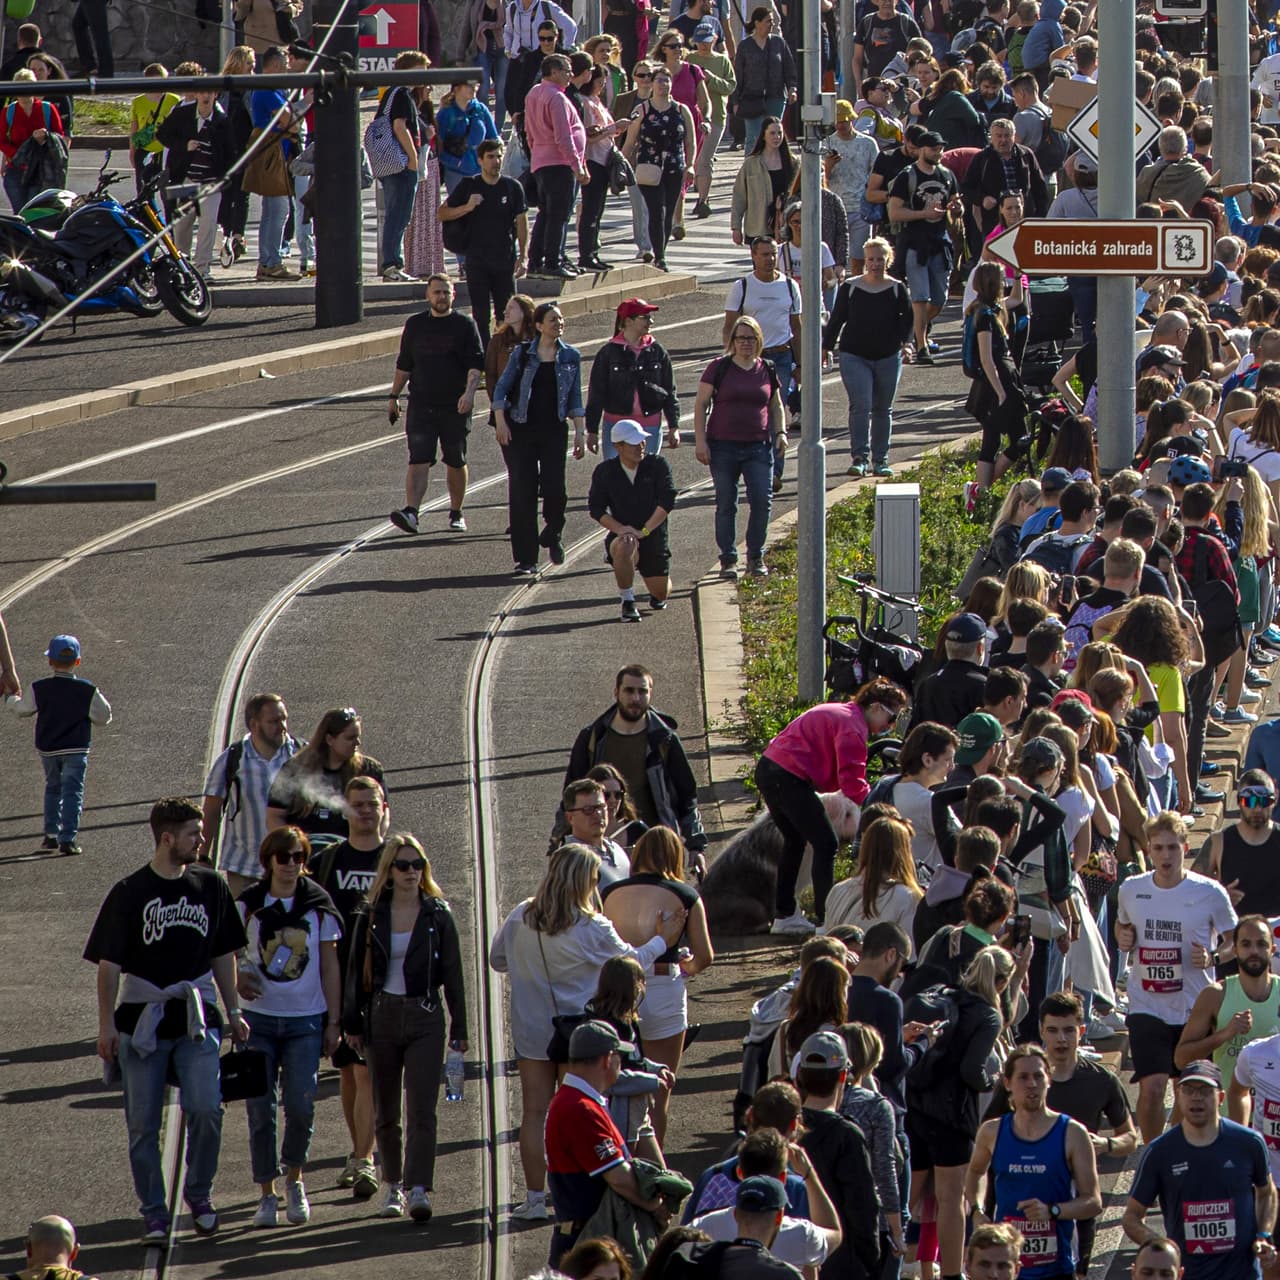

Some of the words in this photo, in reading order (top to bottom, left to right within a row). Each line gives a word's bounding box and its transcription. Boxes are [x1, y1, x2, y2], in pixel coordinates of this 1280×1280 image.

[1034, 240, 1097, 256] Botanická
[1103, 241, 1153, 256] zahrada
[336, 870, 376, 890] VAN
[1142, 950, 1177, 962] RUNCZECH
[1146, 965, 1174, 980] 1765
[1187, 1202, 1230, 1217] RUNCZECH
[1191, 1221, 1228, 1237] 1005
